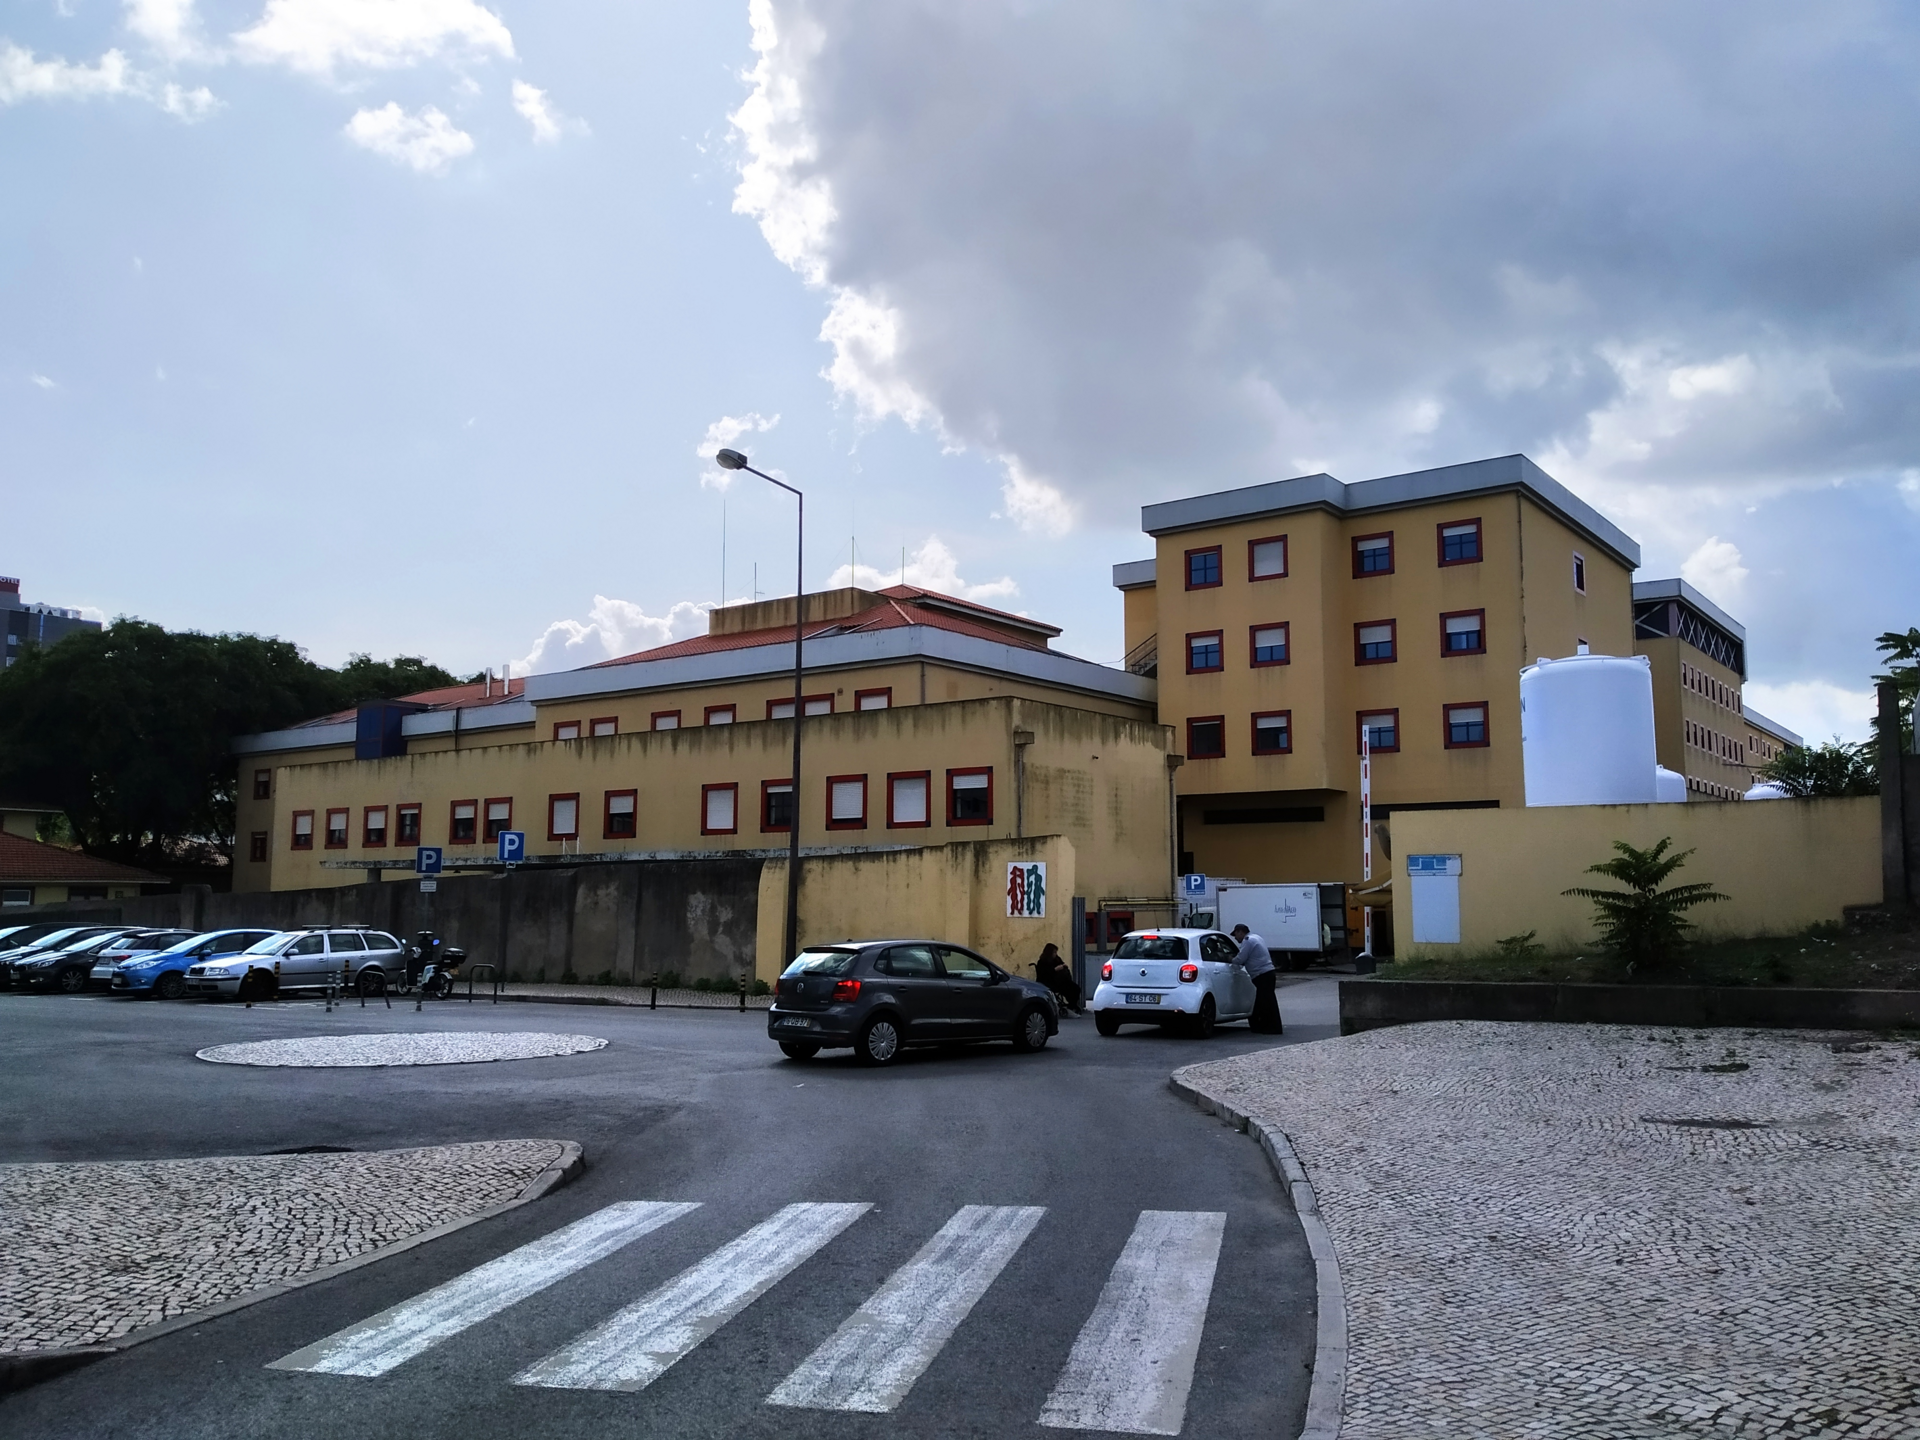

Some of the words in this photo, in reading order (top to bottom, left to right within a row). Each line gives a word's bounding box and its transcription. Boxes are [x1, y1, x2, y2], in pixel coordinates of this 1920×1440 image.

[504, 834, 519, 859] P
[421, 850, 437, 871] P
[1191, 875, 1201, 890] P
